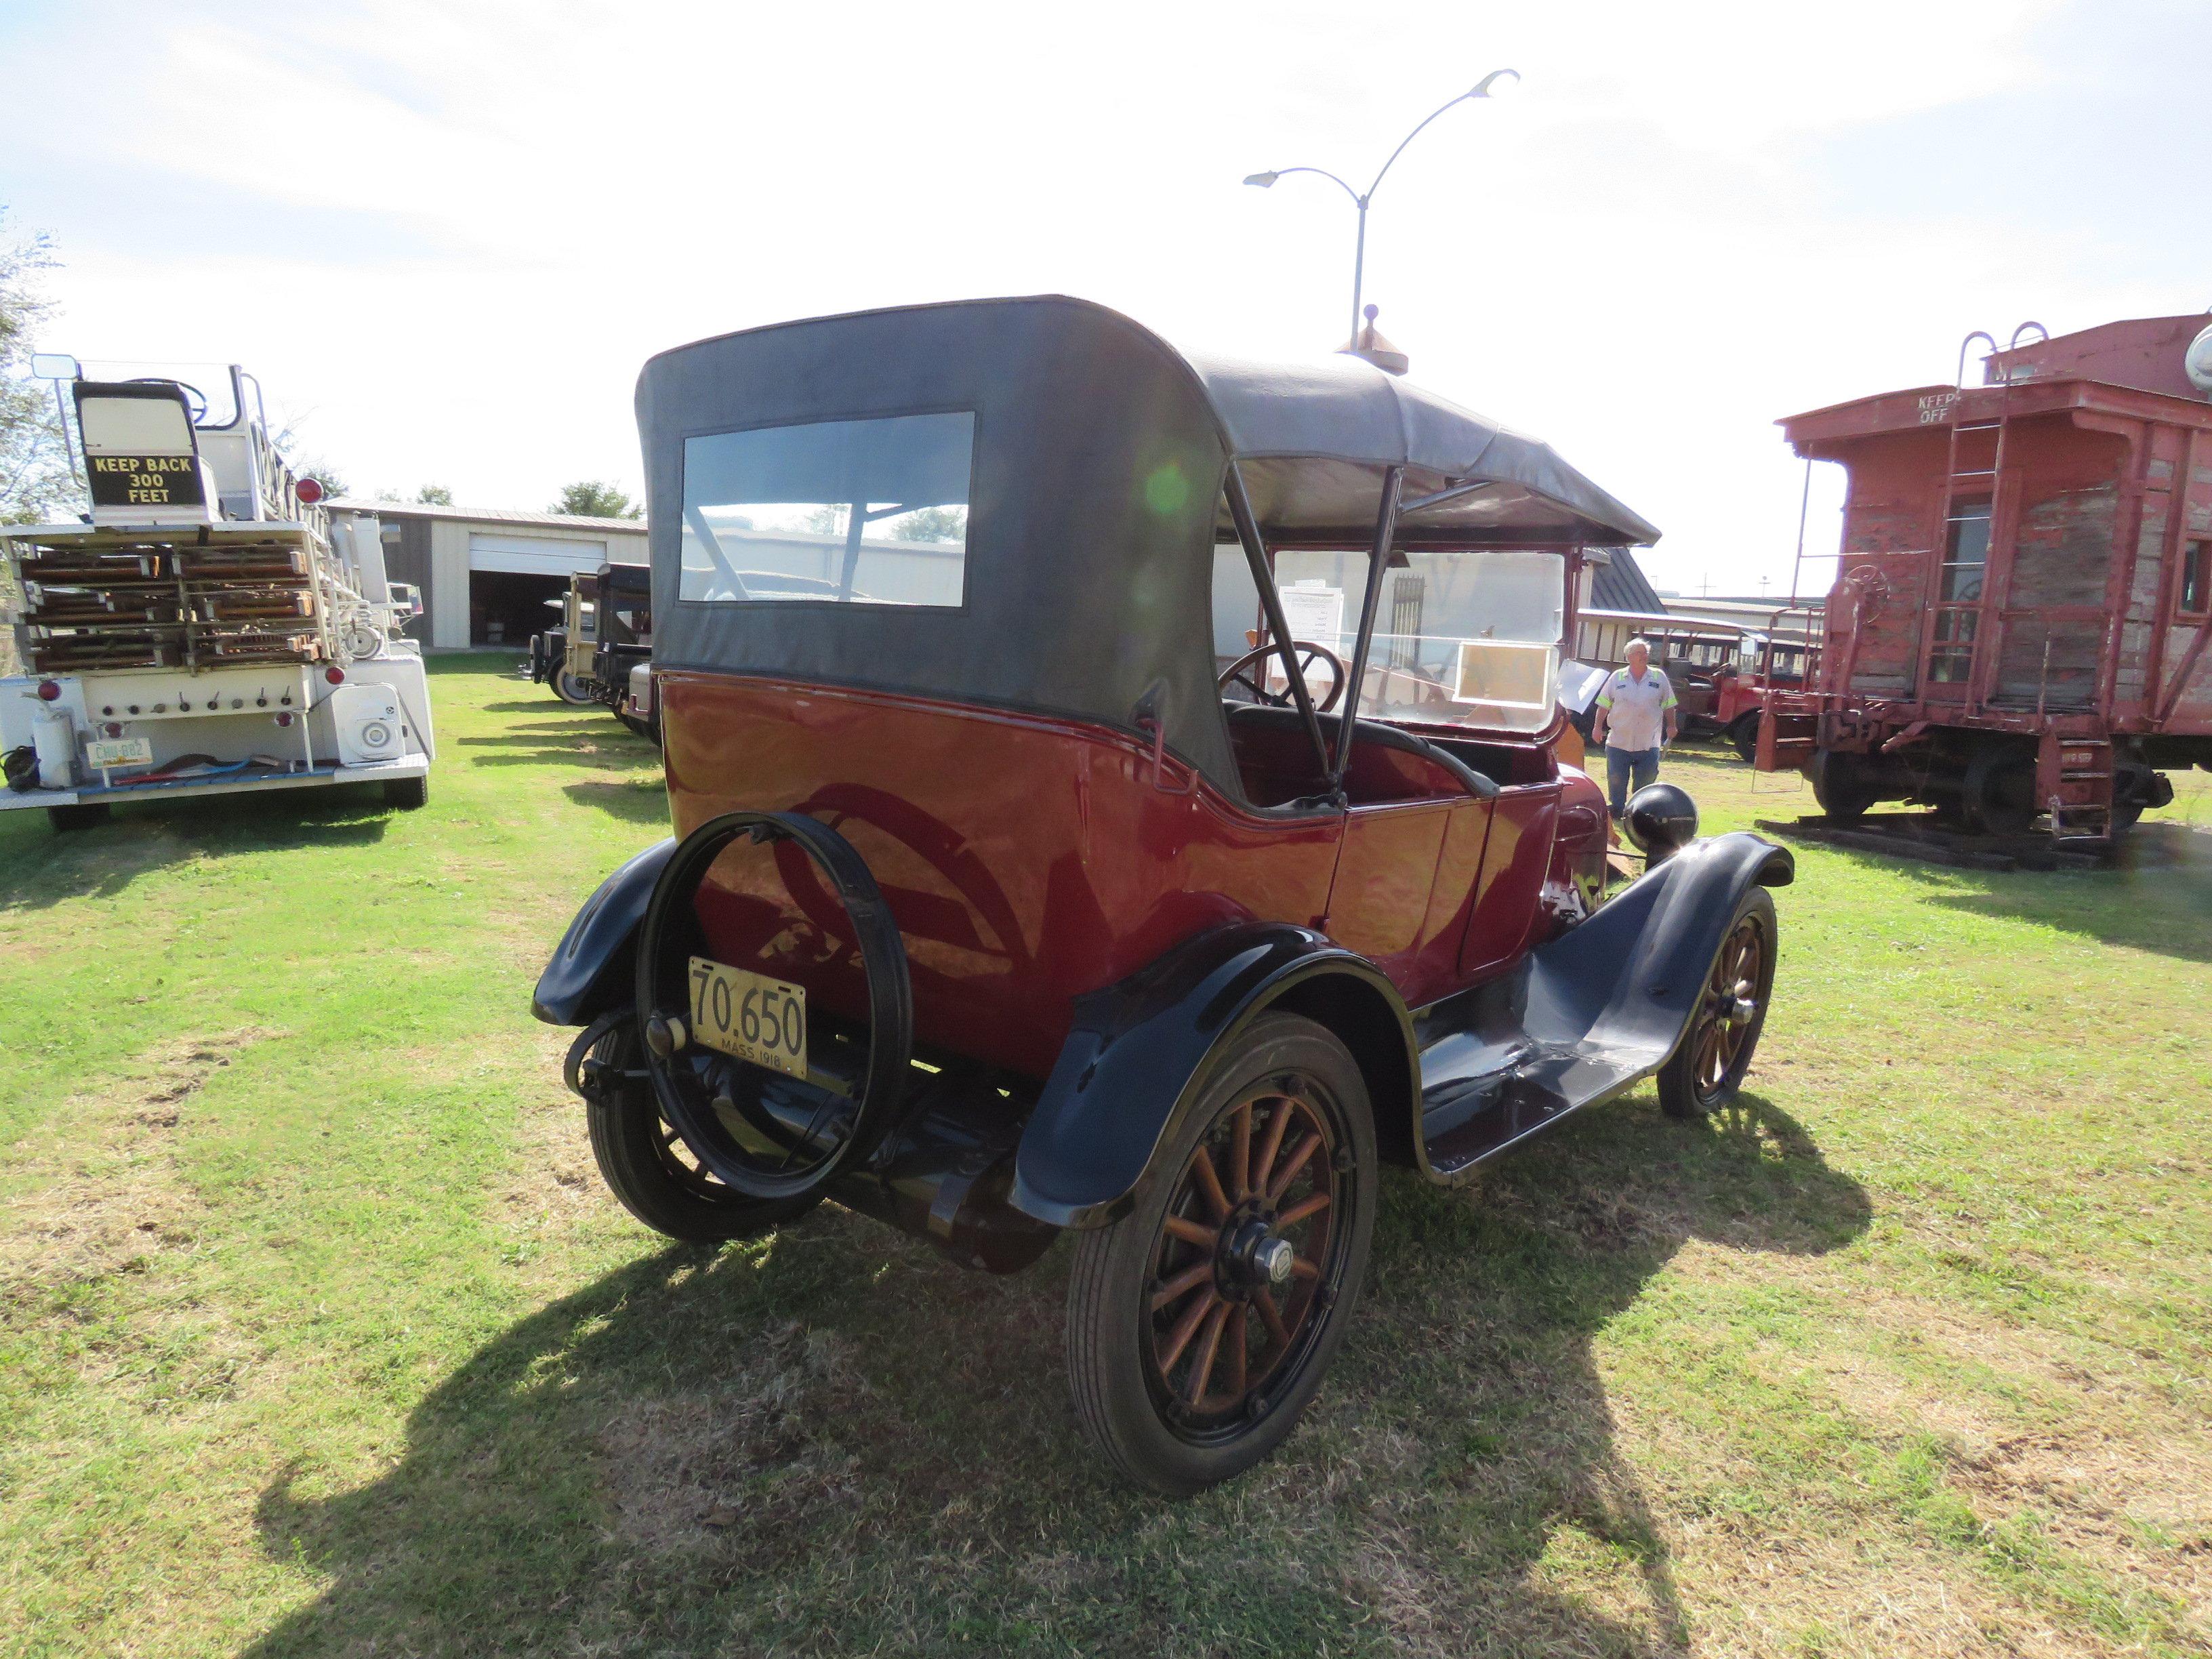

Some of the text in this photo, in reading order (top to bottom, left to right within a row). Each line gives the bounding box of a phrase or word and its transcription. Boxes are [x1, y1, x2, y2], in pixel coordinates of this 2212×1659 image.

[1919, 394, 1954, 408] KEEP
[1920, 409, 1948, 423] OFF
[95, 457, 191, 472] KEEP BACK
[129, 474, 164, 487] 300
[129, 489, 169, 503] FEET
[722, 1038, 781, 1067] MASS 1918
